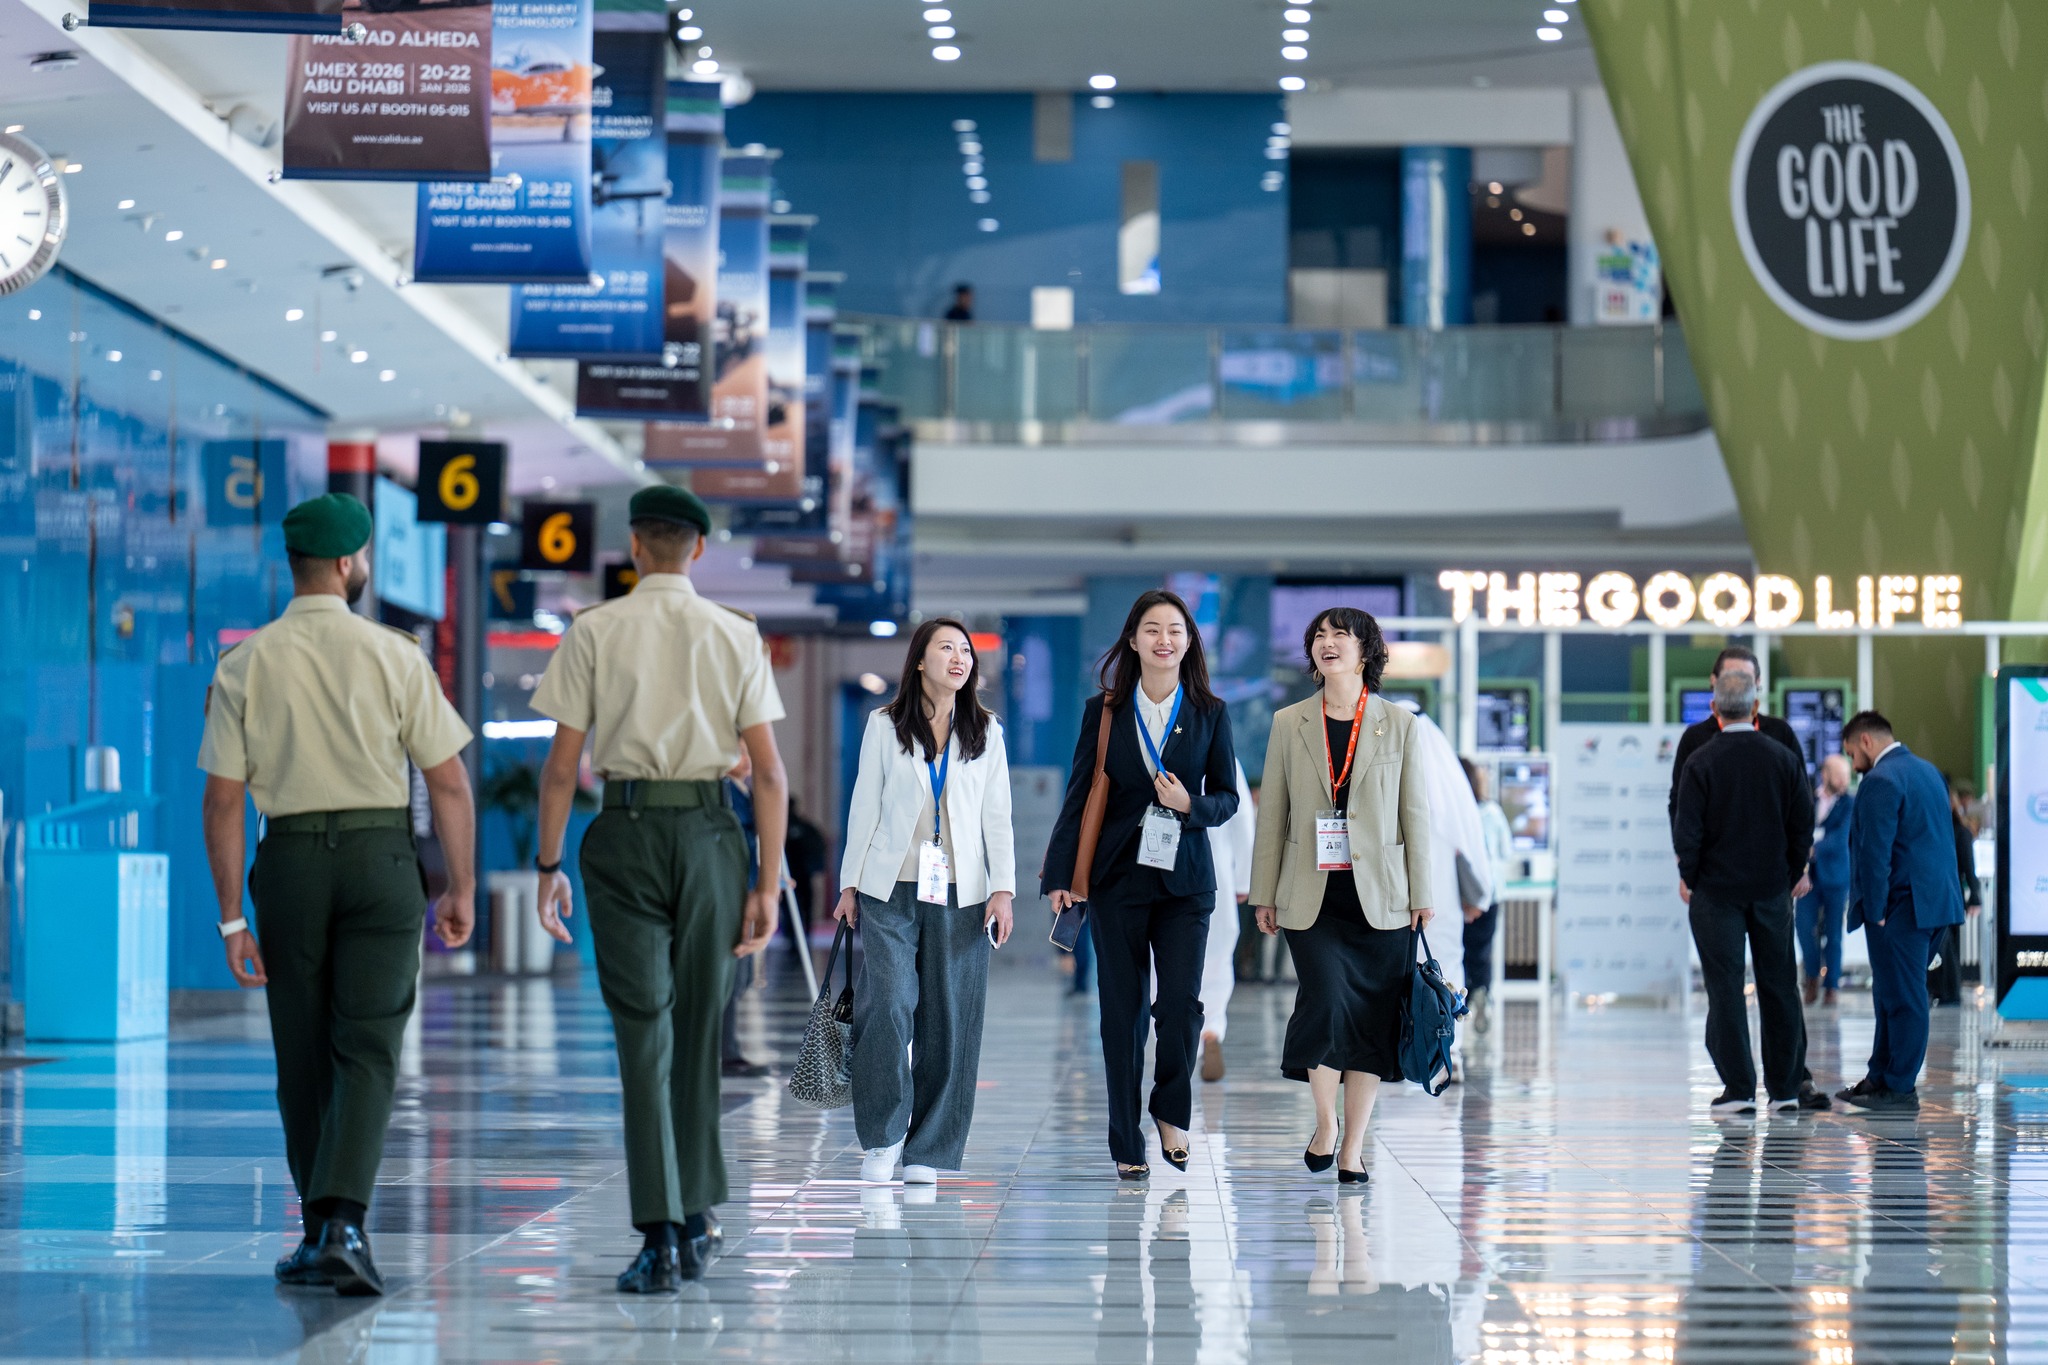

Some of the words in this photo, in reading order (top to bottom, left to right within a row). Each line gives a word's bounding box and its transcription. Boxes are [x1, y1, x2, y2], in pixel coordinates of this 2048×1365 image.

[399, 31, 480, 48] ALHEDA
[304, 62, 357, 78] UMEX
[361, 63, 405, 79] 2026
[419, 64, 471, 81] 20-22
[303, 78, 342, 94] ABU
[346, 79, 404, 95] DHABI
[419, 82, 442, 94] JAN
[444, 82, 471, 94] 2026
[306, 102, 339, 115] VISIT
[341, 102, 360, 115] US
[361, 103, 379, 115] AT
[380, 103, 427, 116] BOOTH
[429, 104, 470, 117] 05-015
[1821, 104, 1866, 143] THE
[352, 134, 423, 145] www.calidus.ae
[1777, 139, 1919, 220] GOOD
[527, 182, 572, 197] 20-22
[429, 195, 463, 210] ABU
[465, 196, 516, 210] DHABI
[1805, 216, 1905, 298] LIFE
[438, 454, 480, 511] 6
[538, 512, 577, 564] 6
[1814, 574, 1962, 629] LIFE
